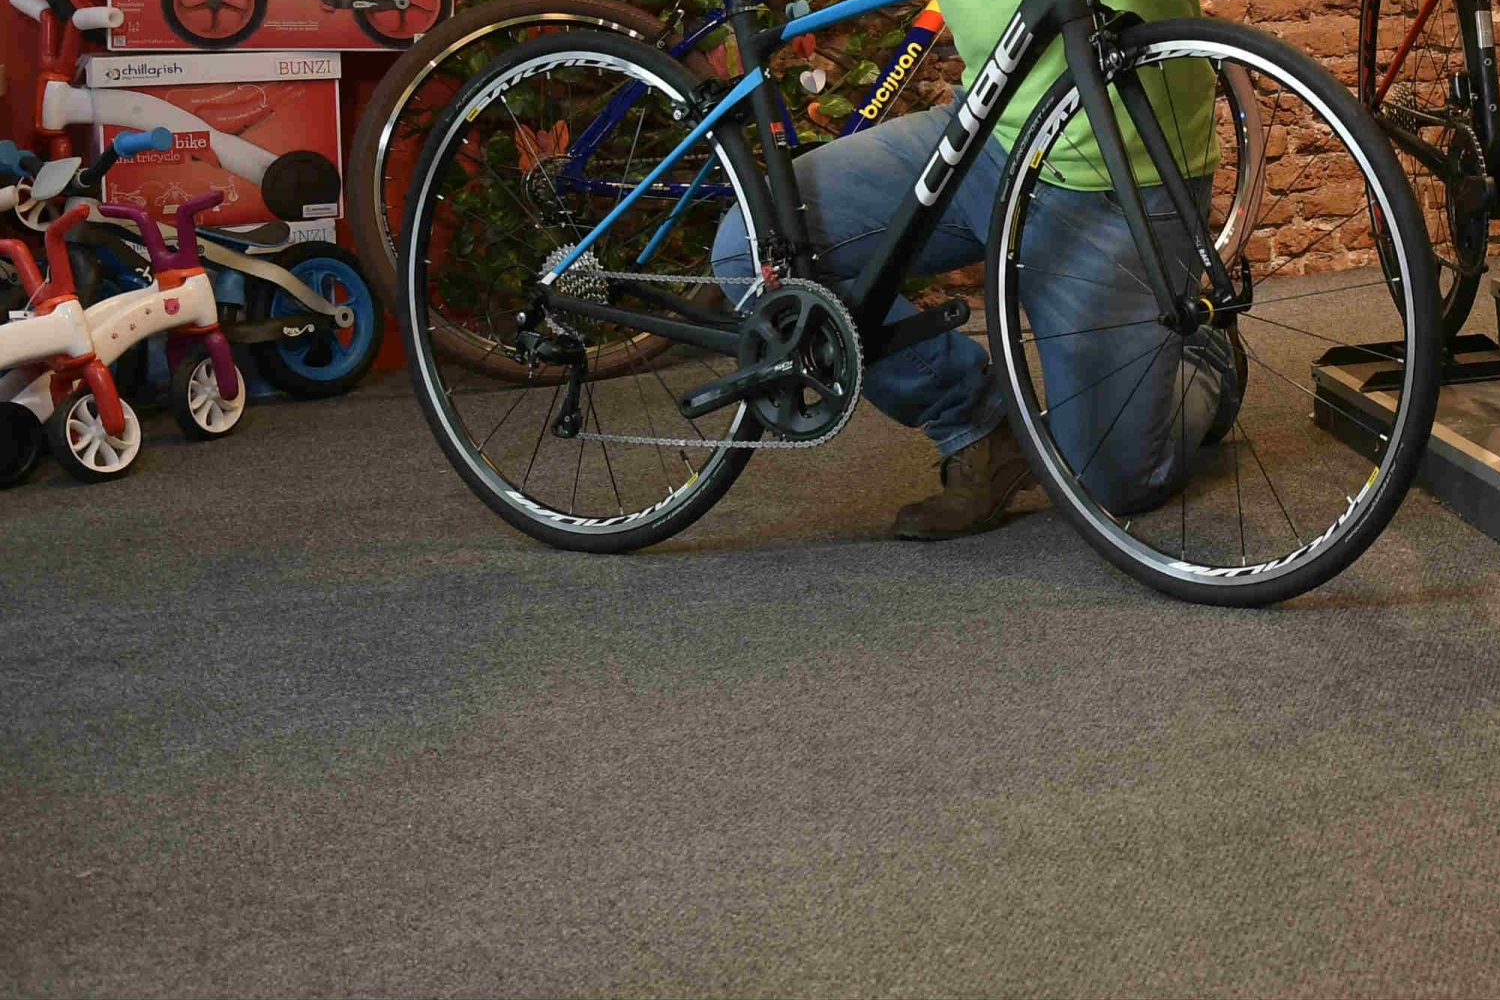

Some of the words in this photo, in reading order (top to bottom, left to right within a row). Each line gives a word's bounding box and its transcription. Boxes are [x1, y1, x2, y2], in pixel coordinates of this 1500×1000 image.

[121, 63, 183, 79] chillafish
[279, 60, 332, 76] BUNZI
[914, 11, 1035, 207] CUBE
[175, 133, 208, 150] bike
[136, 150, 181, 164] tricycle
[291, 228, 328, 243] UNZI
